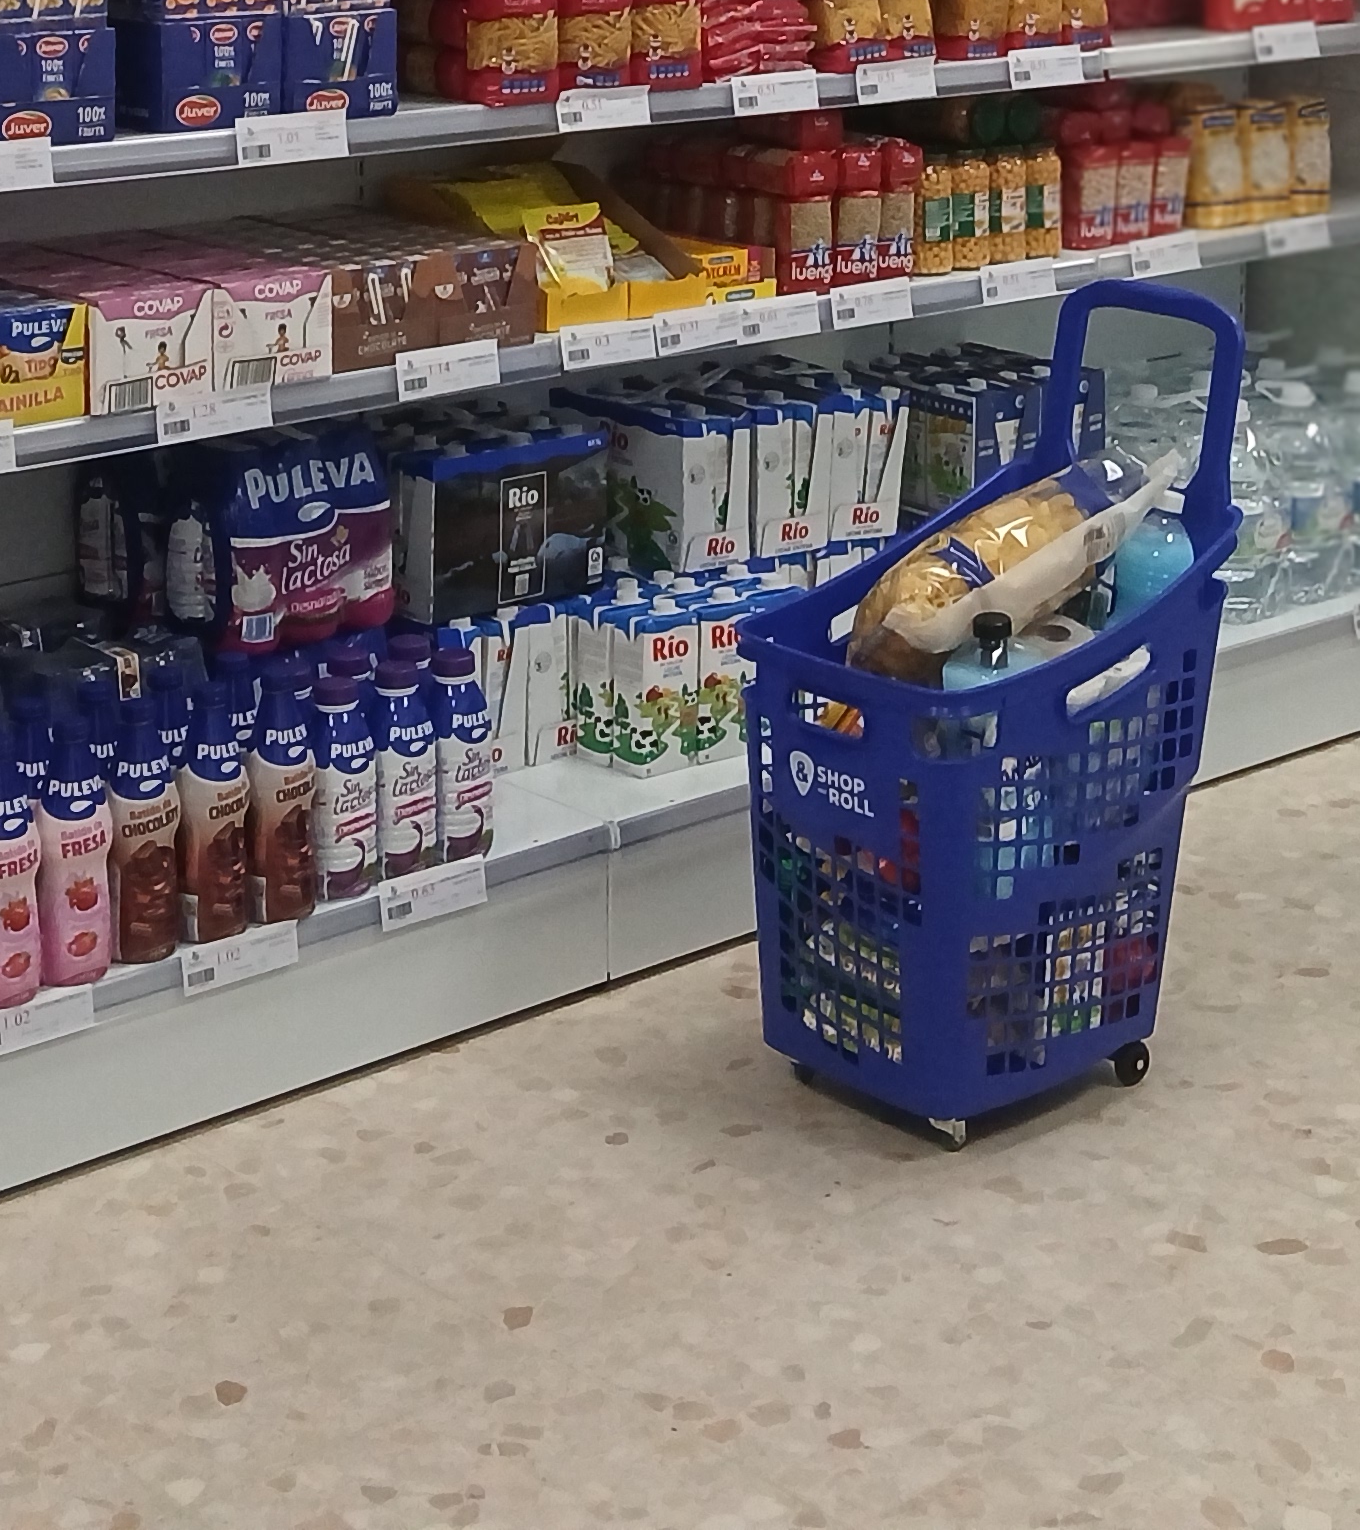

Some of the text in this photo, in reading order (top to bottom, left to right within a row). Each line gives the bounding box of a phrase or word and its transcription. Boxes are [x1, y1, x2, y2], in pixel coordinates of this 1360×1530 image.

[41, 60, 63, 72] 100%
[77, 106, 105, 123] 100%
[181, 105, 217, 118] Juver
[7, 122, 46, 136] Juver
[255, 280, 302, 298] COVAP
[133, 297, 183, 316] COVAP
[280, 350, 322, 367] COVAP
[155, 365, 207, 390] COVAP
[244, 452, 375, 509] PULEVA
[508, 486, 539, 509] Río
[852, 507, 880, 525] Río
[781, 522, 809, 541] Río
[288, 540, 318, 568] Sin
[707, 536, 735, 557] Río
[281, 544, 350, 595] lactosa
[652, 635, 689, 662] Río
[464, 748, 481, 766] Sin
[402, 762, 419, 780] Sin
[817, 766, 866, 794] SHOP
[342, 778, 361, 798] Sin
[61, 829, 107, 859] FRESA
